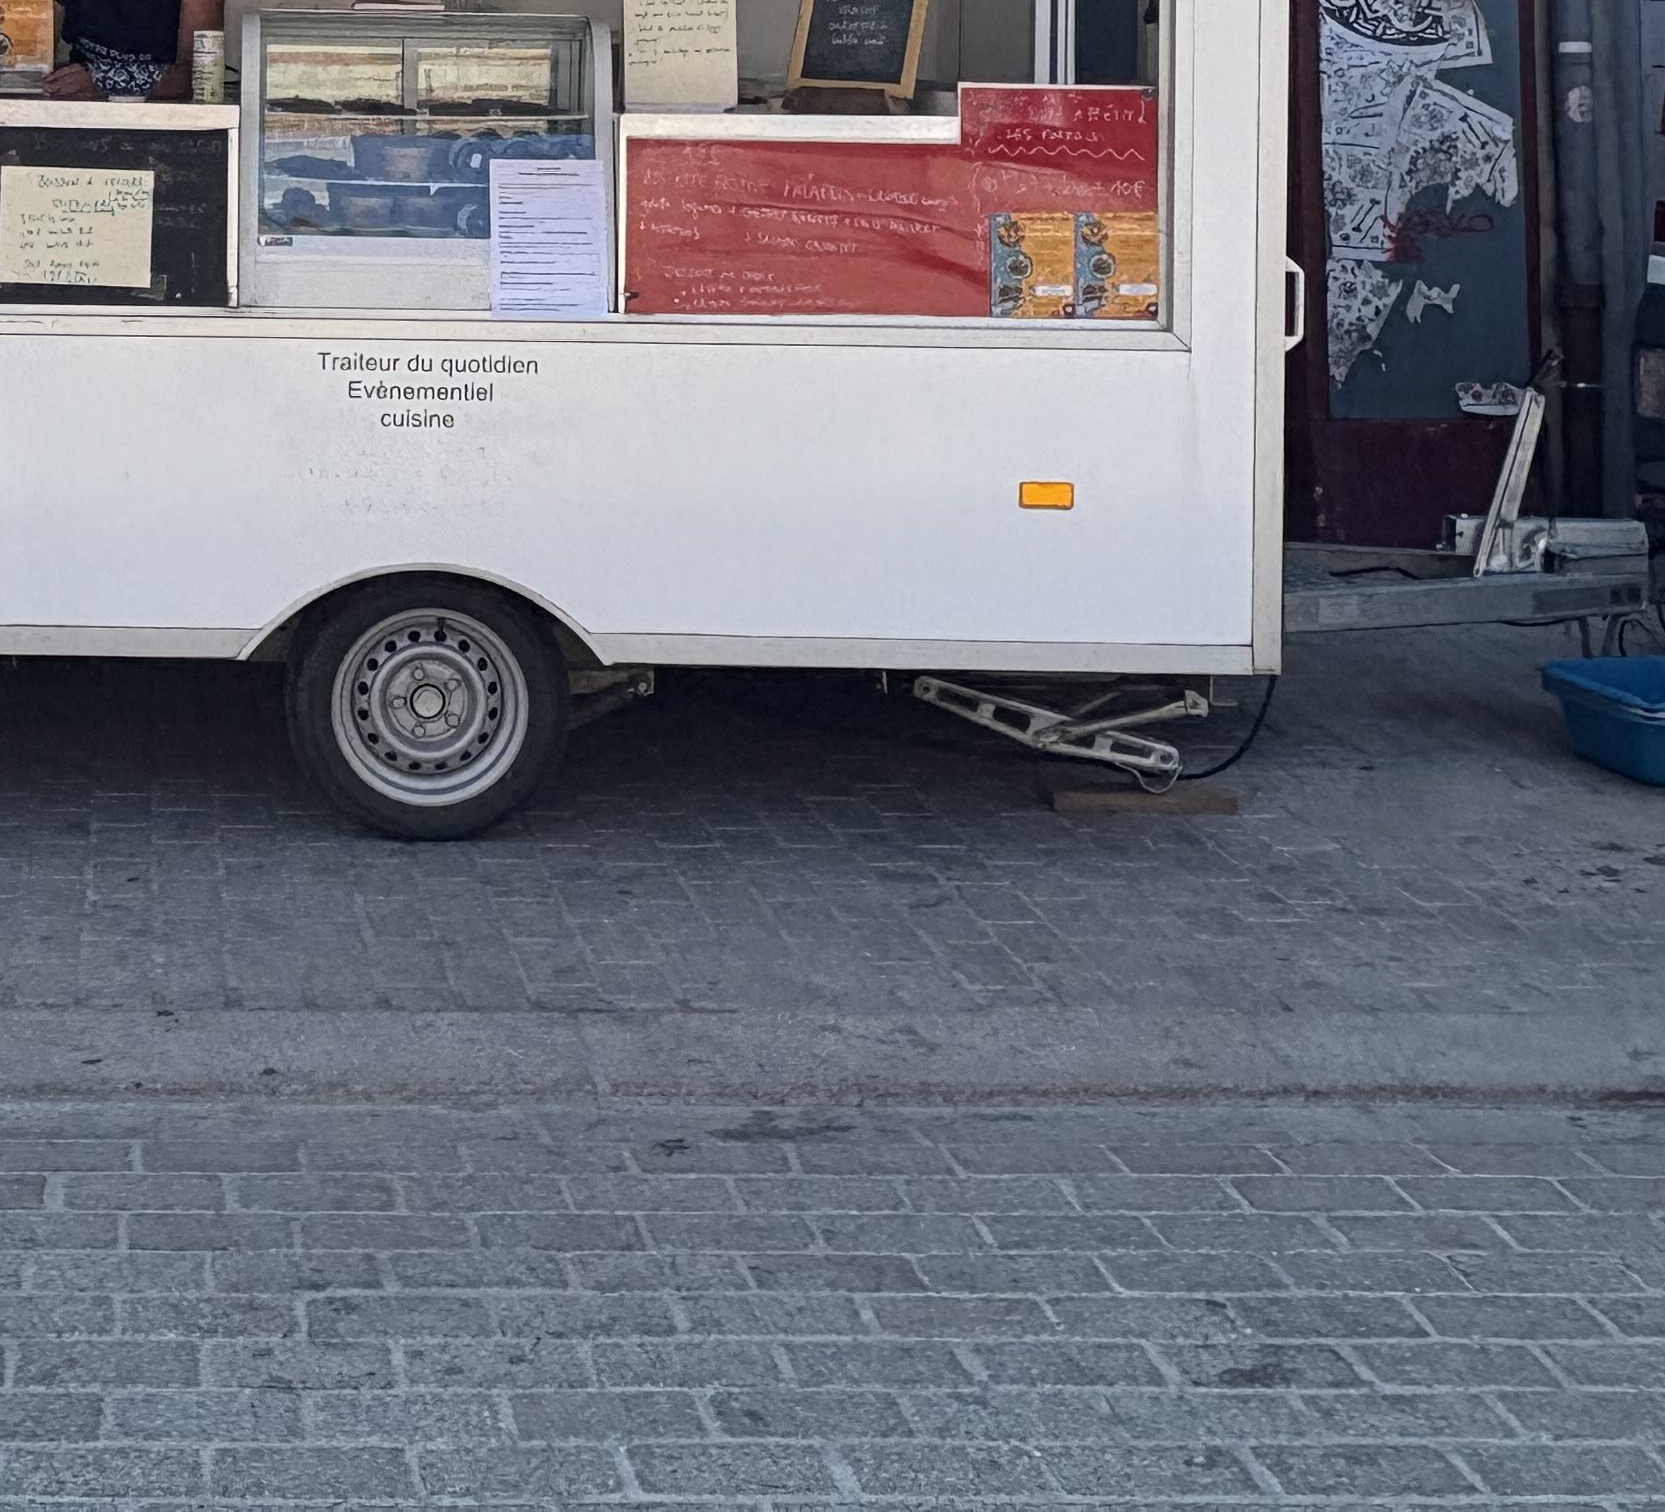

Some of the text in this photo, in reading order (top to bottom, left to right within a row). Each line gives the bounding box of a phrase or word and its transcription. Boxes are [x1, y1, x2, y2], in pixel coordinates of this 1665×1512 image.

[318, 352, 539, 377] Traiteur du quotidien
[380, 409, 455, 429] cuisine
